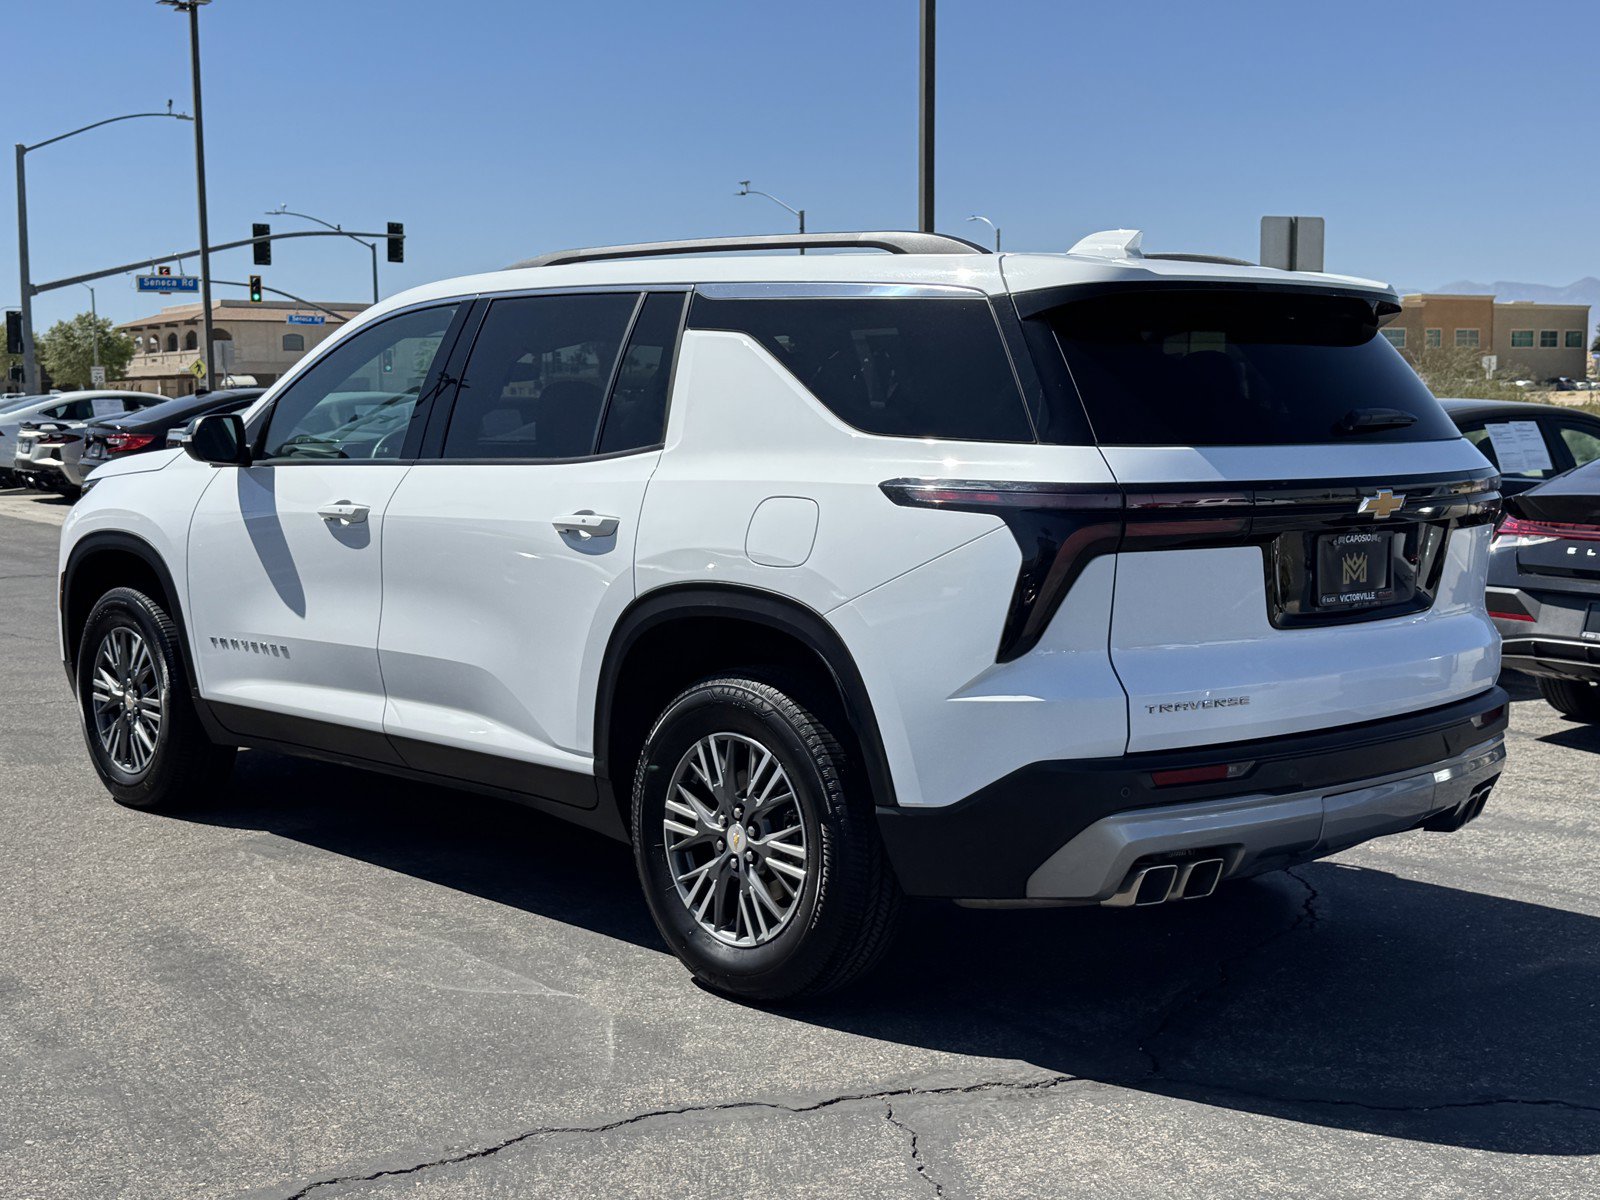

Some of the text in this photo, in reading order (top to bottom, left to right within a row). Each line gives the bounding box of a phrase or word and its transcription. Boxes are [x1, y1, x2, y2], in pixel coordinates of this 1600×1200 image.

[143, 278, 194, 287] Seneca Rd
[1345, 533, 1371, 543] CAPOSIO
[1339, 591, 1376, 603] VICTORVILLE
[208, 636, 291, 660] TRAVERSE
[718, 686, 765, 710] ALENZA
[1144, 696, 1251, 714] TRAVERSE
